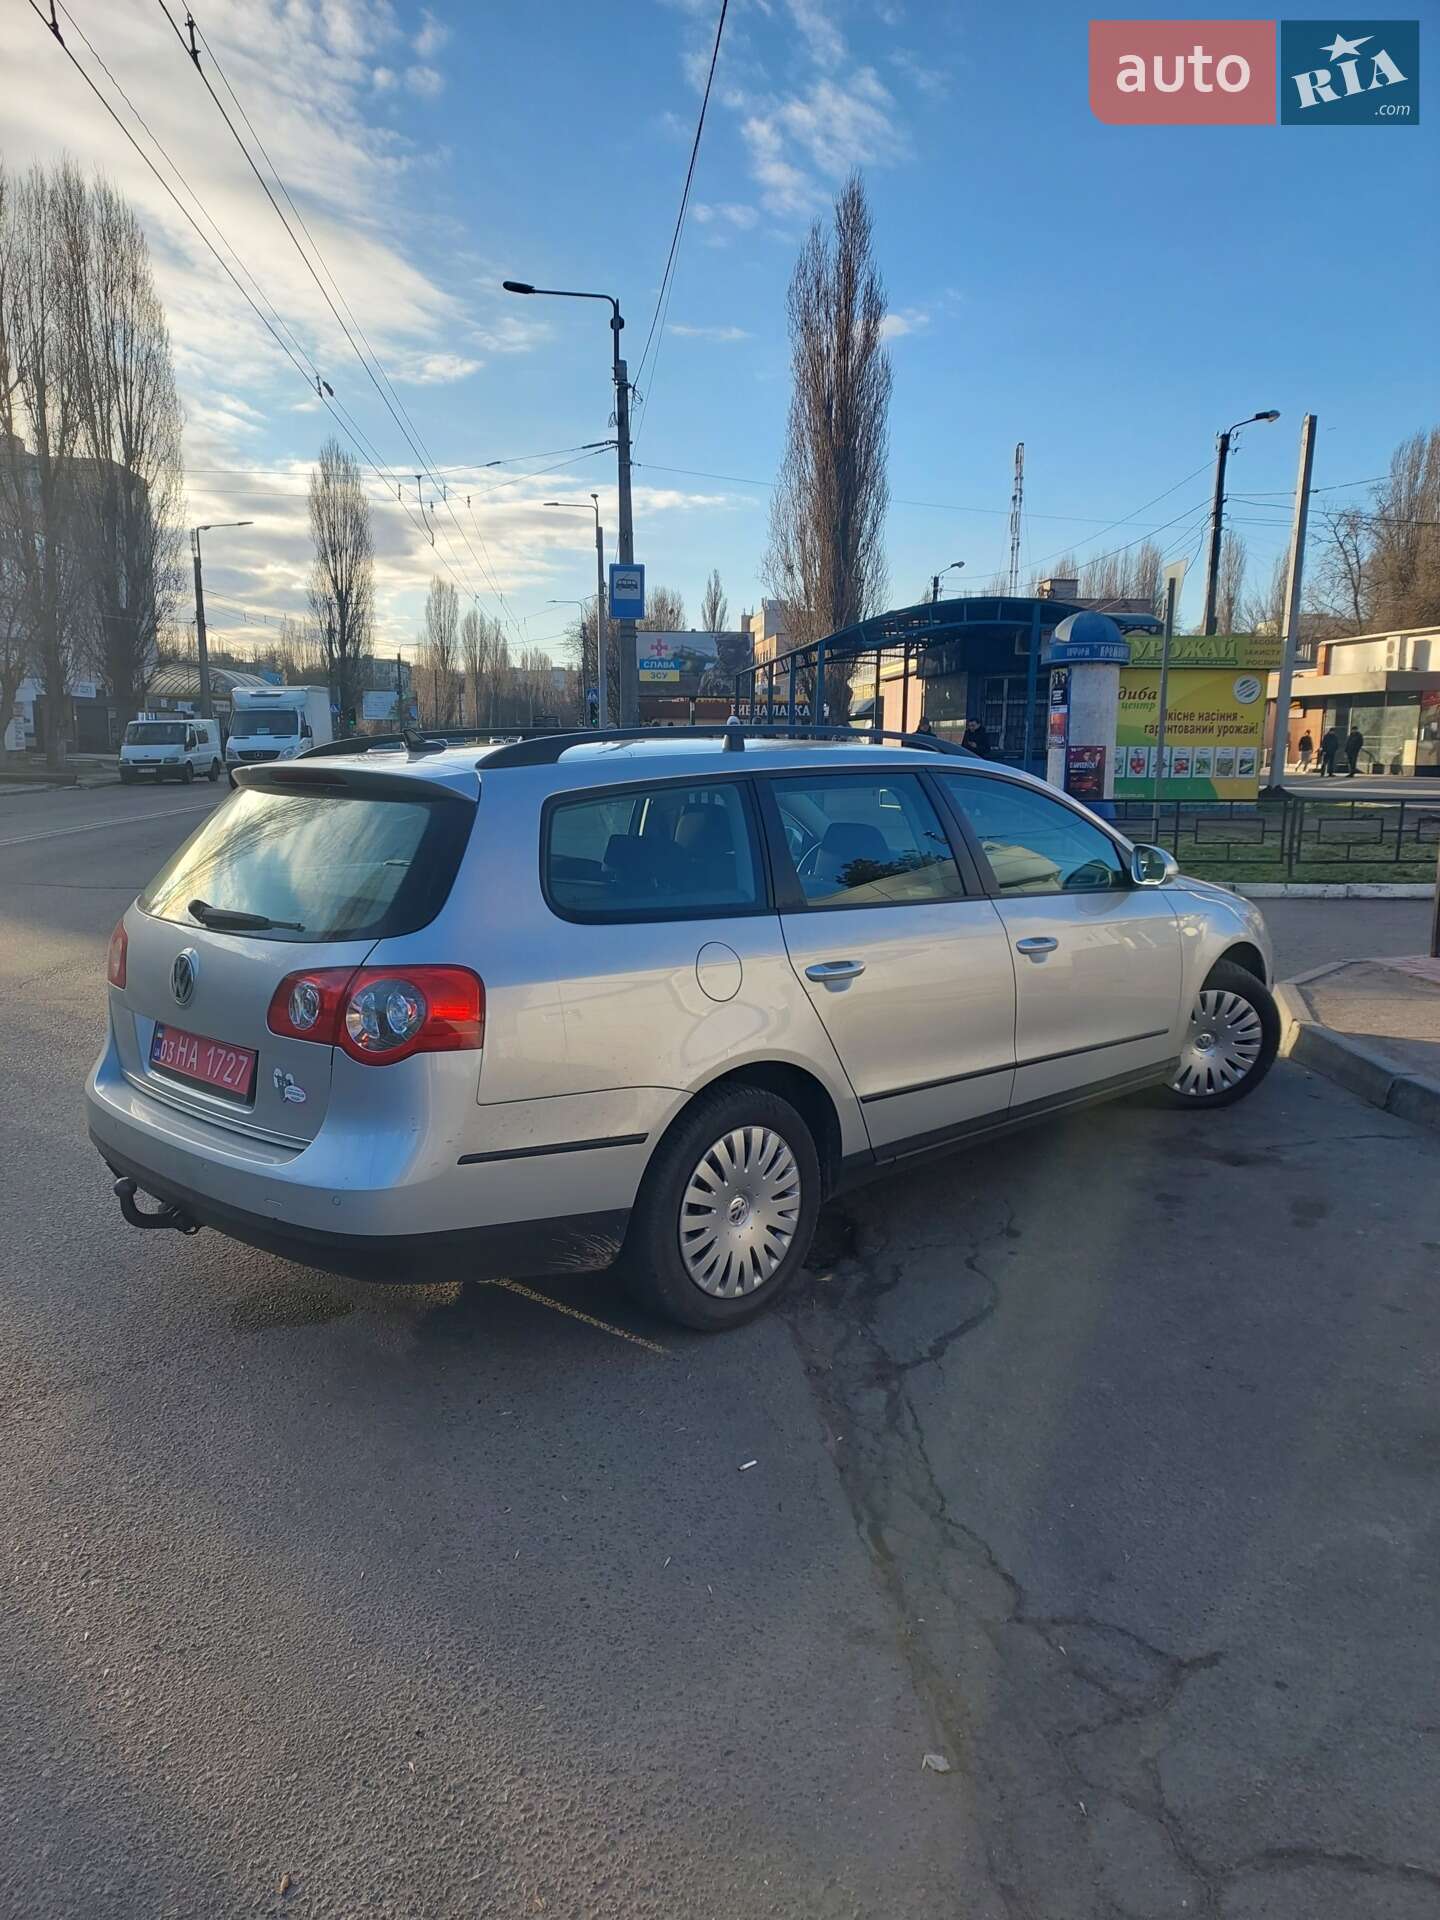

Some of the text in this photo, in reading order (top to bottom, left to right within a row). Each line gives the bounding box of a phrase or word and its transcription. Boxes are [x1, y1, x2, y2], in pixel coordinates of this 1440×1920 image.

[1134, 639, 1237, 659] УРОЖАЙ
[643, 660, 676, 669] СЛАВА
[649, 671, 668, 680] ЗСУ
[1117, 686, 1158, 700] диба
[772, 704, 811, 717] ЛАКА
[1121, 701, 1156, 712] центр
[1166, 709, 1196, 722] кісне
[1198, 709, 1238, 722] насіння
[1144, 722, 1215, 737] гарнтований
[207, 1046, 249, 1087] 1727
